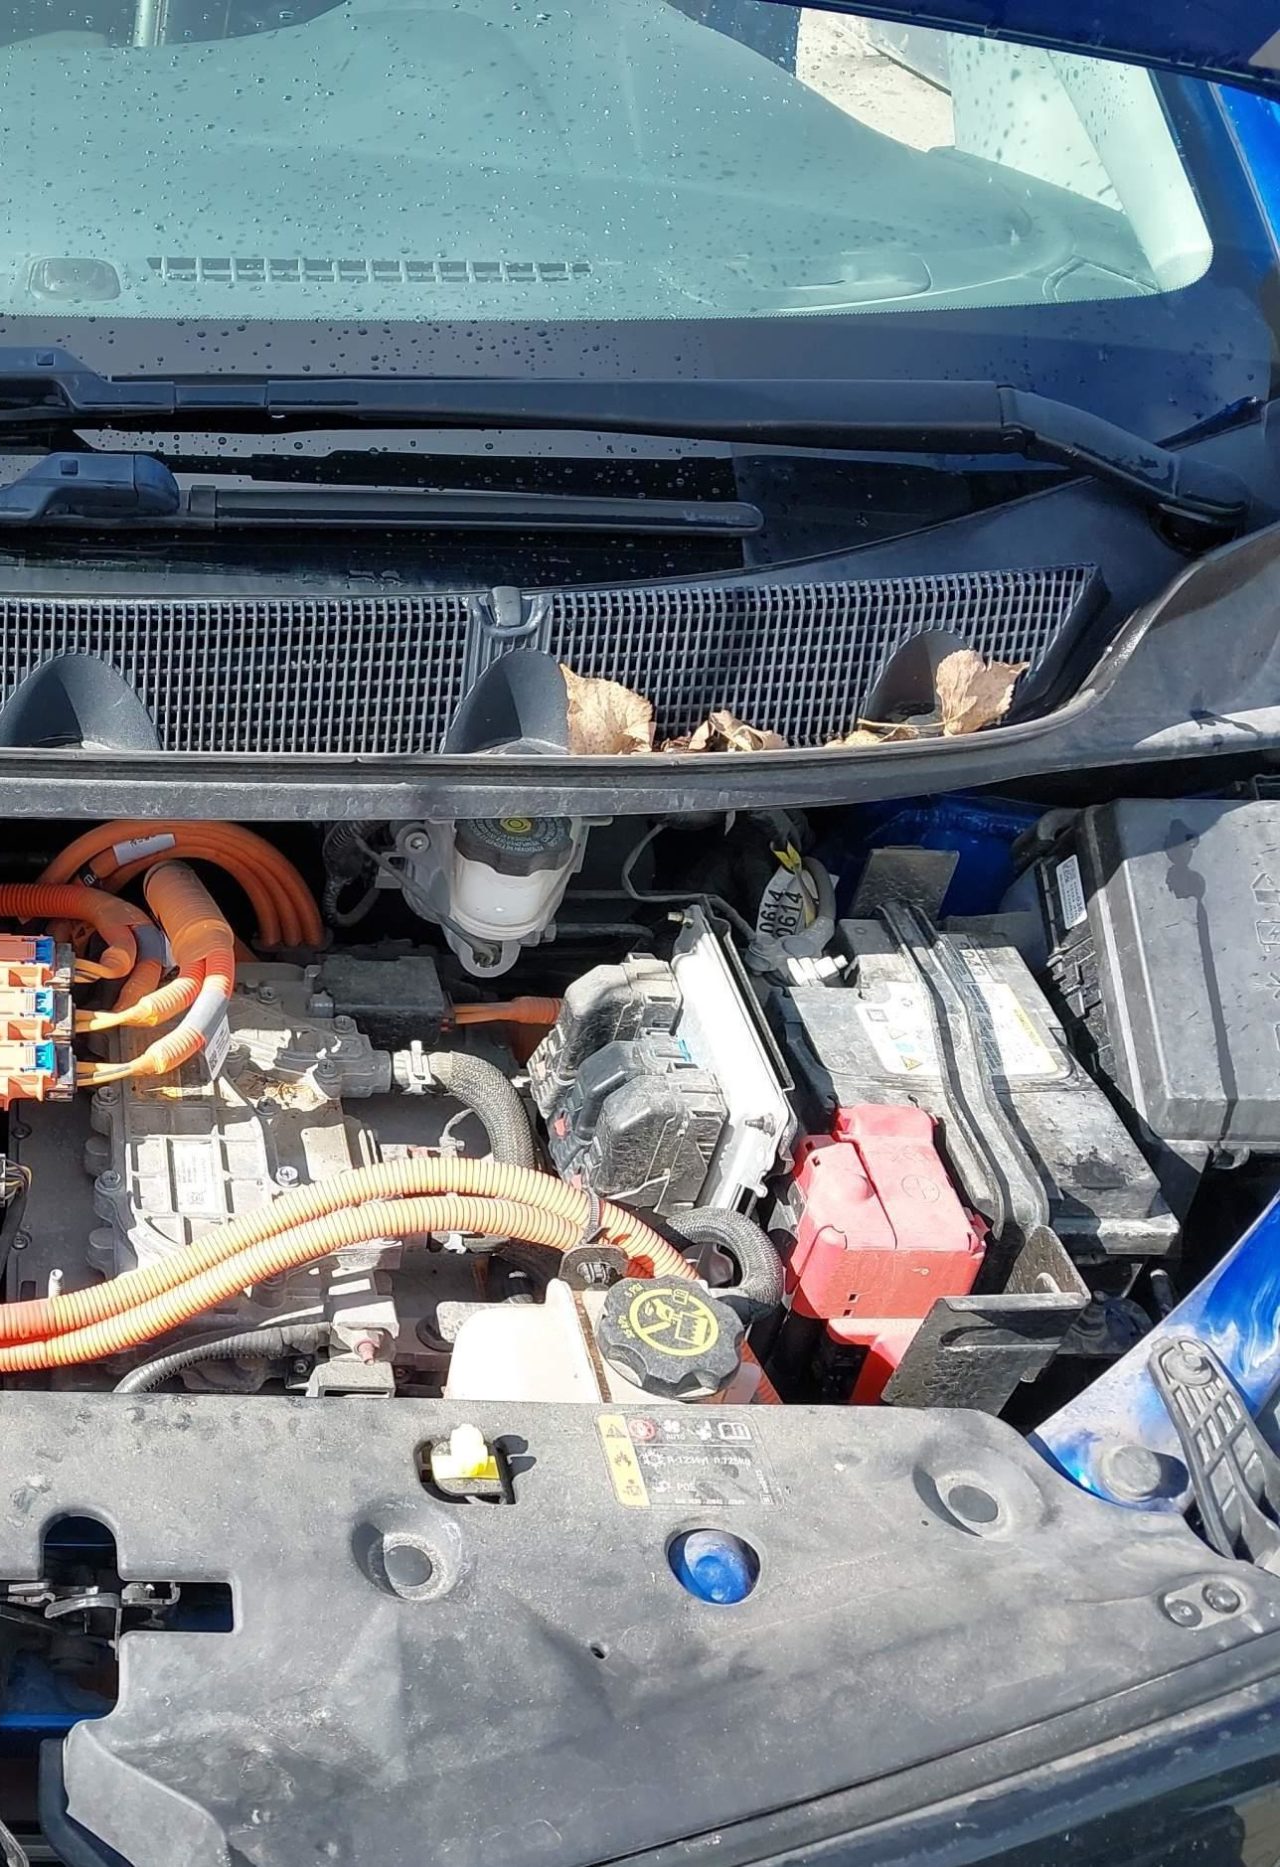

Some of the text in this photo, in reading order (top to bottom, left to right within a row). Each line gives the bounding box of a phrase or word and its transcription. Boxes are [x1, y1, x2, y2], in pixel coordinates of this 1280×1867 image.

[759, 889, 783, 934] 0614
[775, 891, 803, 937] 0614
[666, 1433, 687, 1441] AUTO
